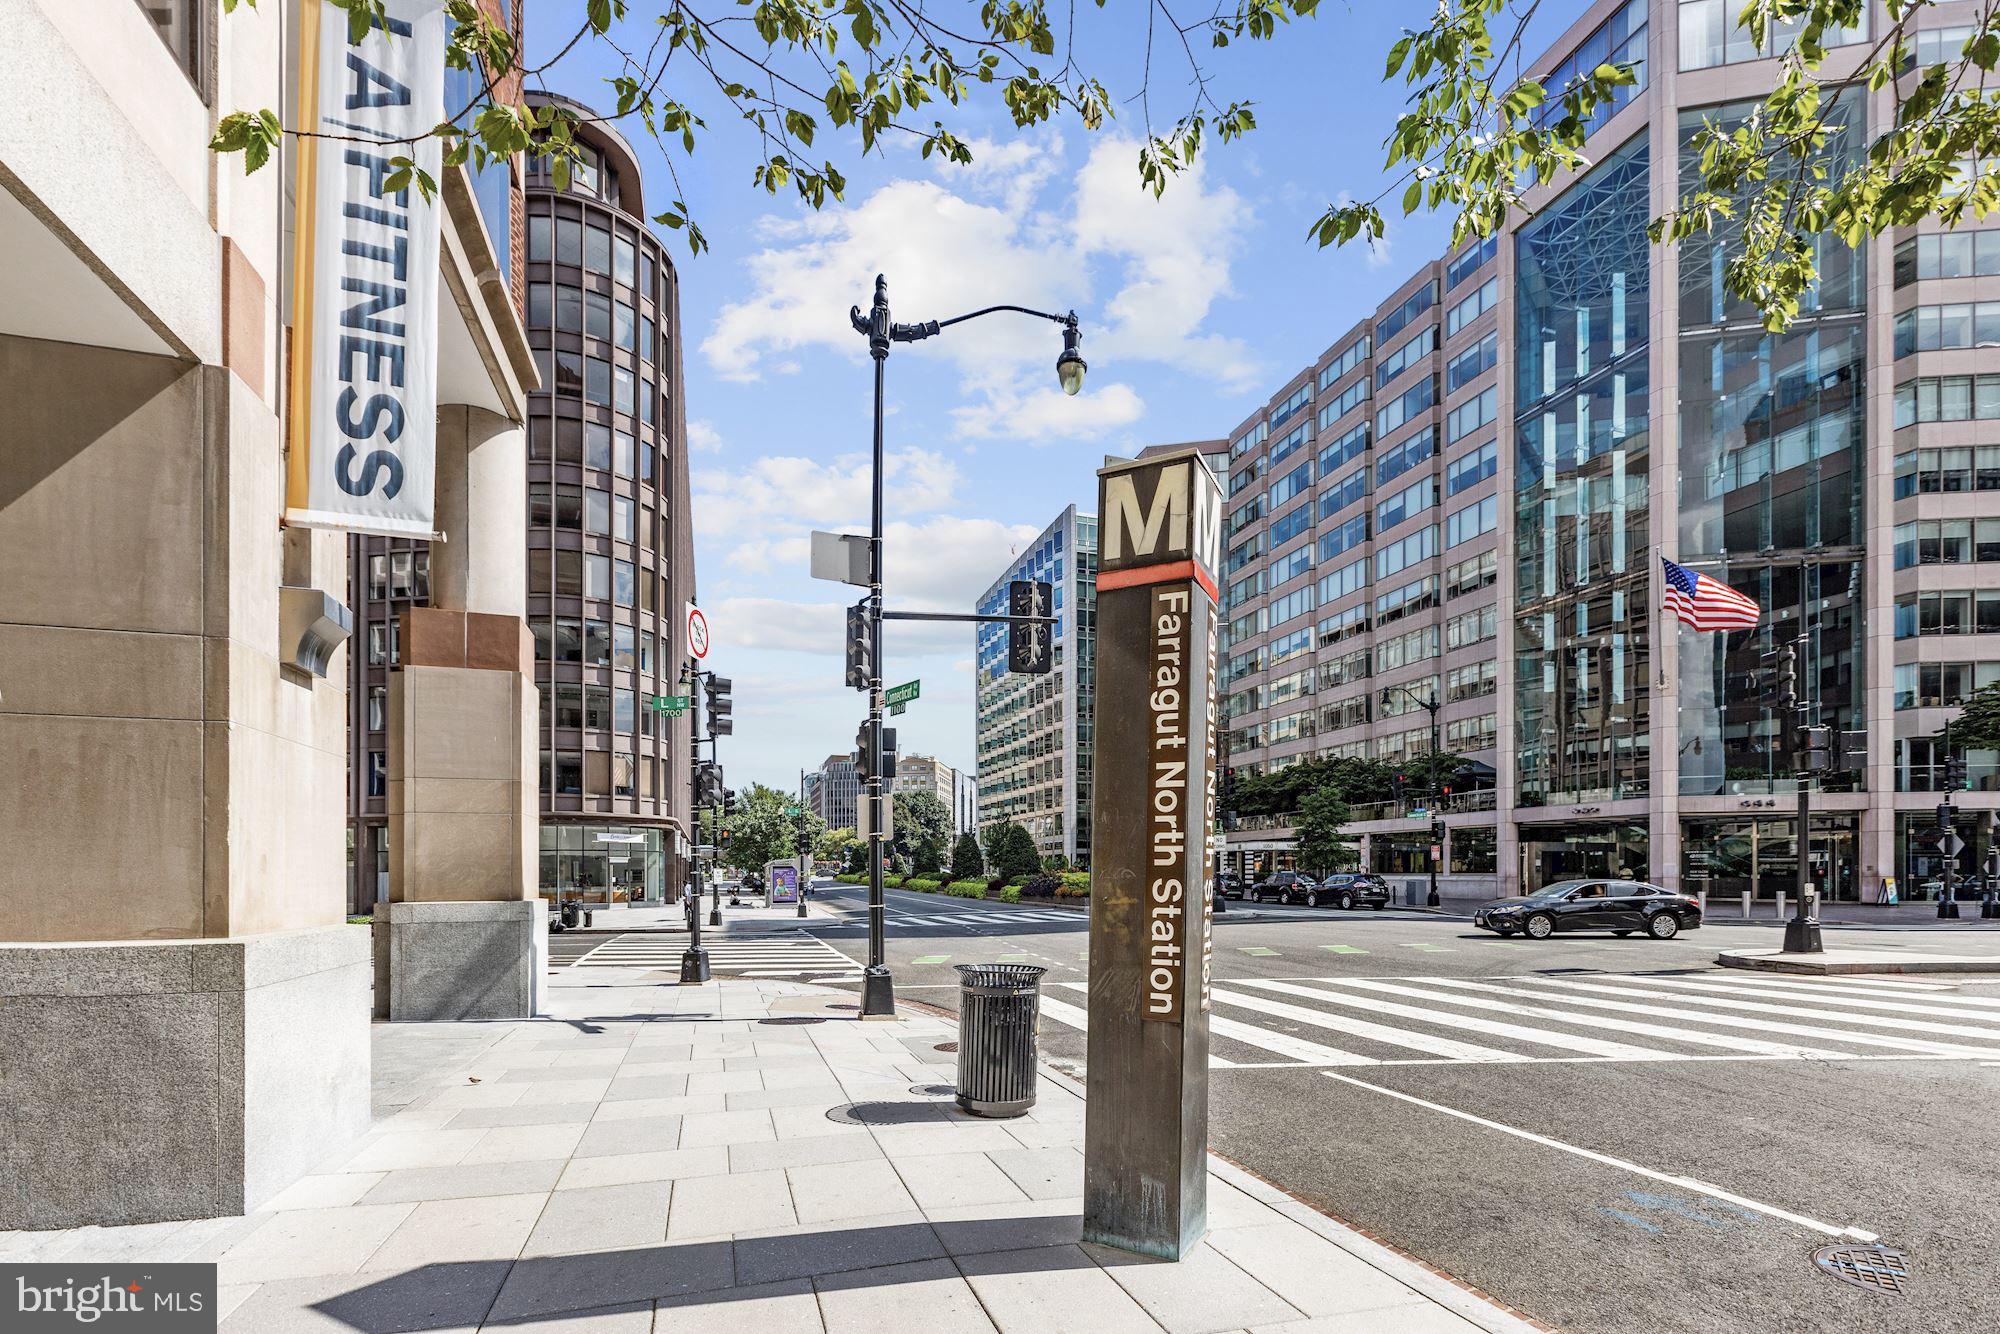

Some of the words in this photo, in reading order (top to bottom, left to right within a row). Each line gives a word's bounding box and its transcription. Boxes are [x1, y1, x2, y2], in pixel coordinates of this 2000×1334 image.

[1104, 463, 1189, 560] M
[1194, 466, 1222, 579] M
[660, 698, 669, 708] L
[661, 709, 681, 717] 1700
[891, 702, 906, 716] 1100
[1150, 590, 1189, 750] Farragut
[1206, 611, 1218, 760] Farragut
[1154, 761, 1186, 866] North
[1205, 769, 1216, 868] North
[1150, 878, 1183, 1014] Station
[1201, 878, 1214, 1007] Station
